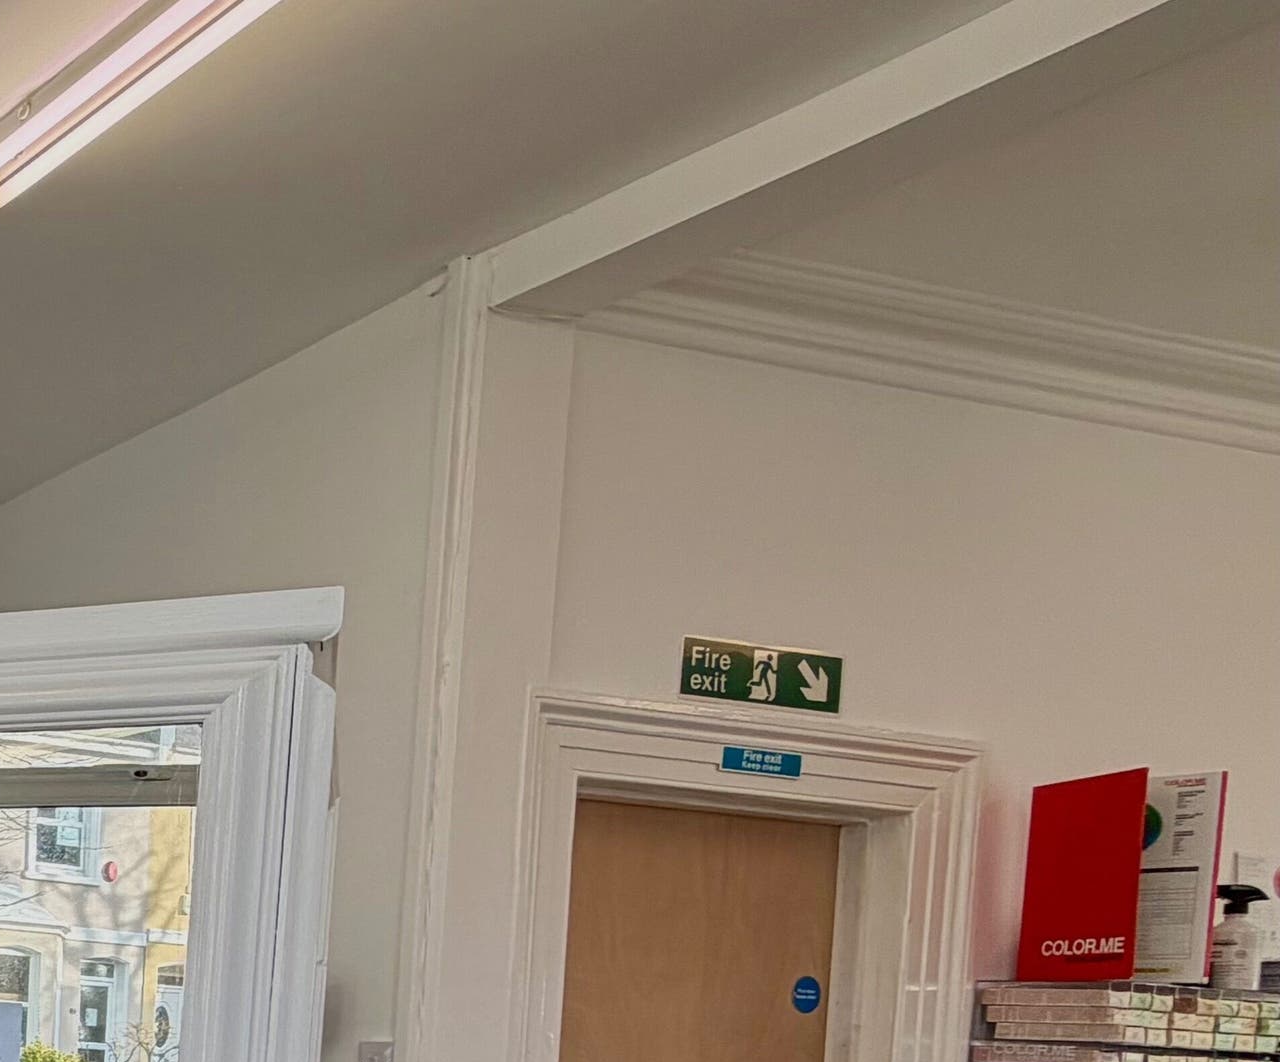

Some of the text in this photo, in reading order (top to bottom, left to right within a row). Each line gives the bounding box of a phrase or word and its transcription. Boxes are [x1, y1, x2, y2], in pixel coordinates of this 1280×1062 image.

[691, 646, 732, 670] Fire
[690, 672, 728, 693] exit
[743, 750, 782, 764] Fire exit
[1041, 936, 1126, 956] COLOR.ME
